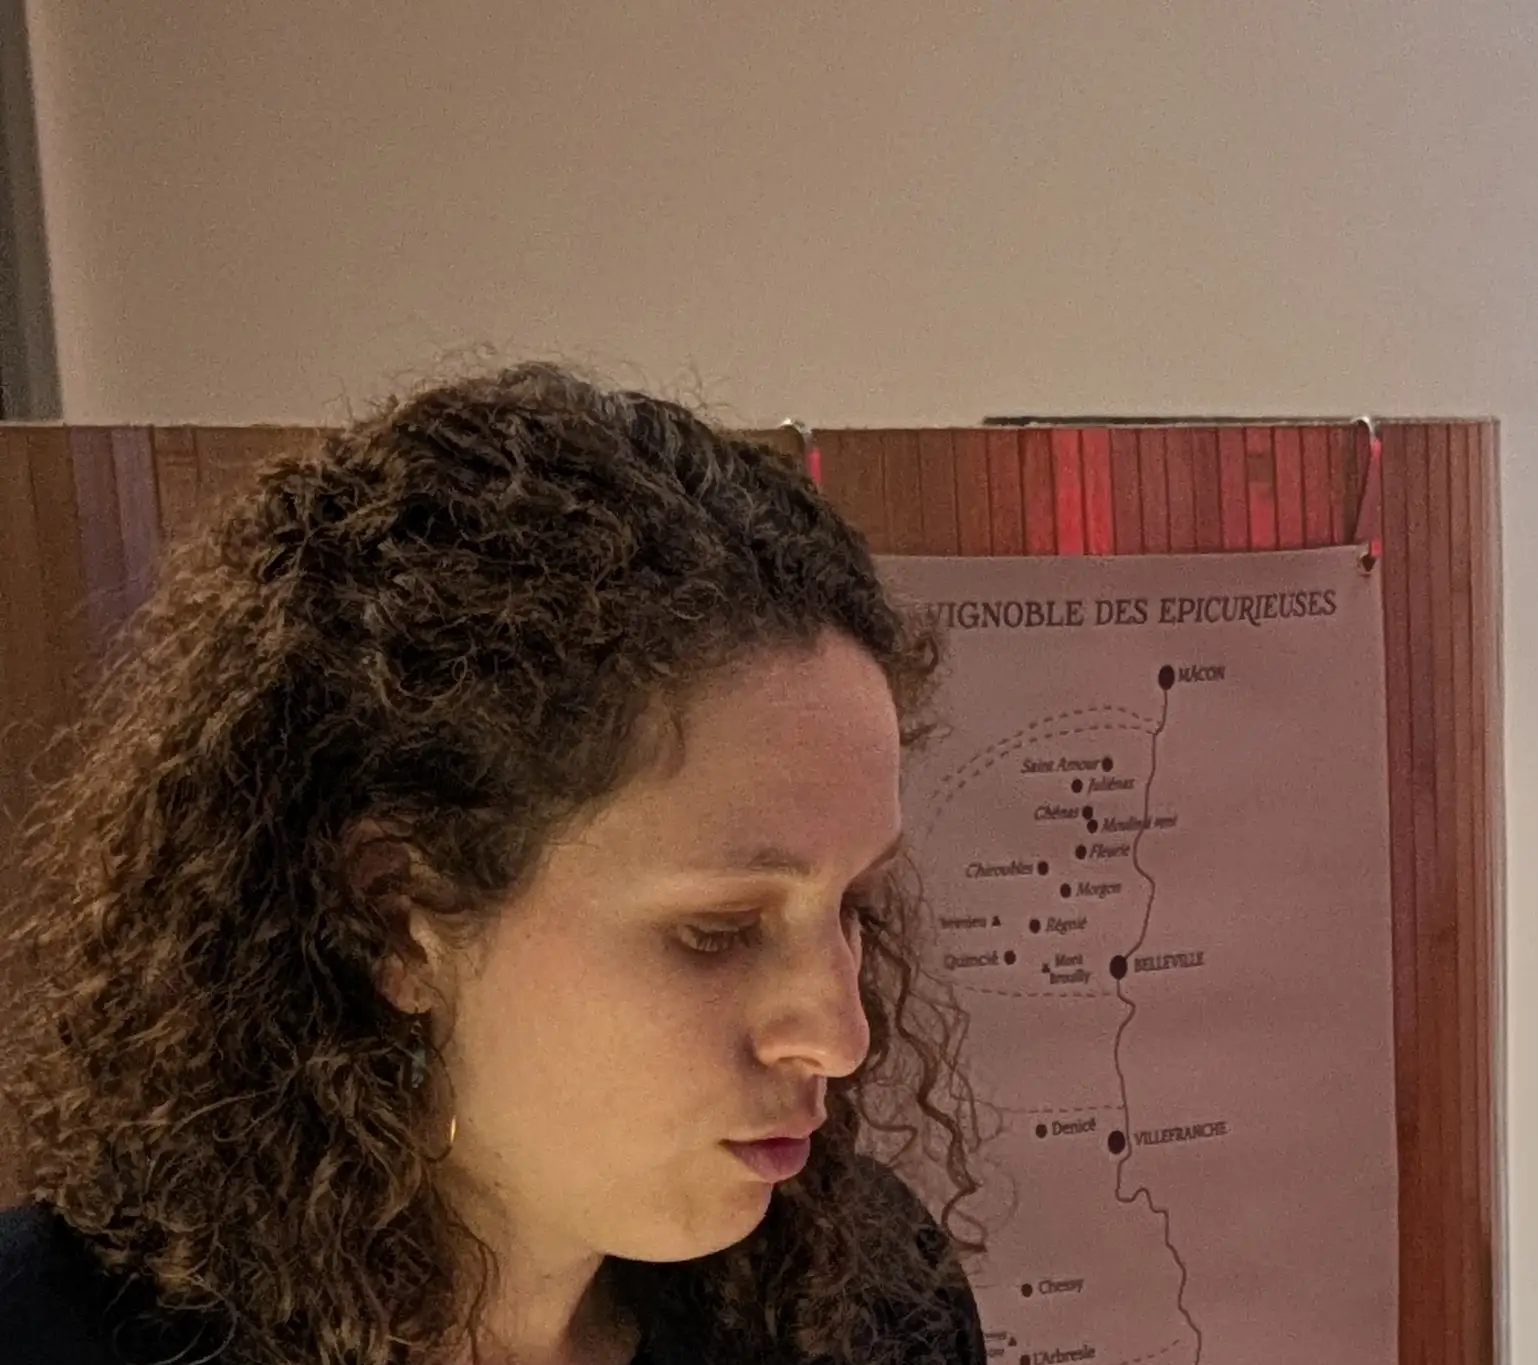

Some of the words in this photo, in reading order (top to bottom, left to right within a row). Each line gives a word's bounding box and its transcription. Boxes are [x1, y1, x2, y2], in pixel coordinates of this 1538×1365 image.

[1095, 597, 1149, 627] DES
[1158, 589, 1337, 627] EPICURIEUSES
[1089, 843, 1131, 859] Fleurie
[1076, 881, 1122, 899] Morgon
[1134, 1120, 1230, 1146] VILLEFRANCHE
